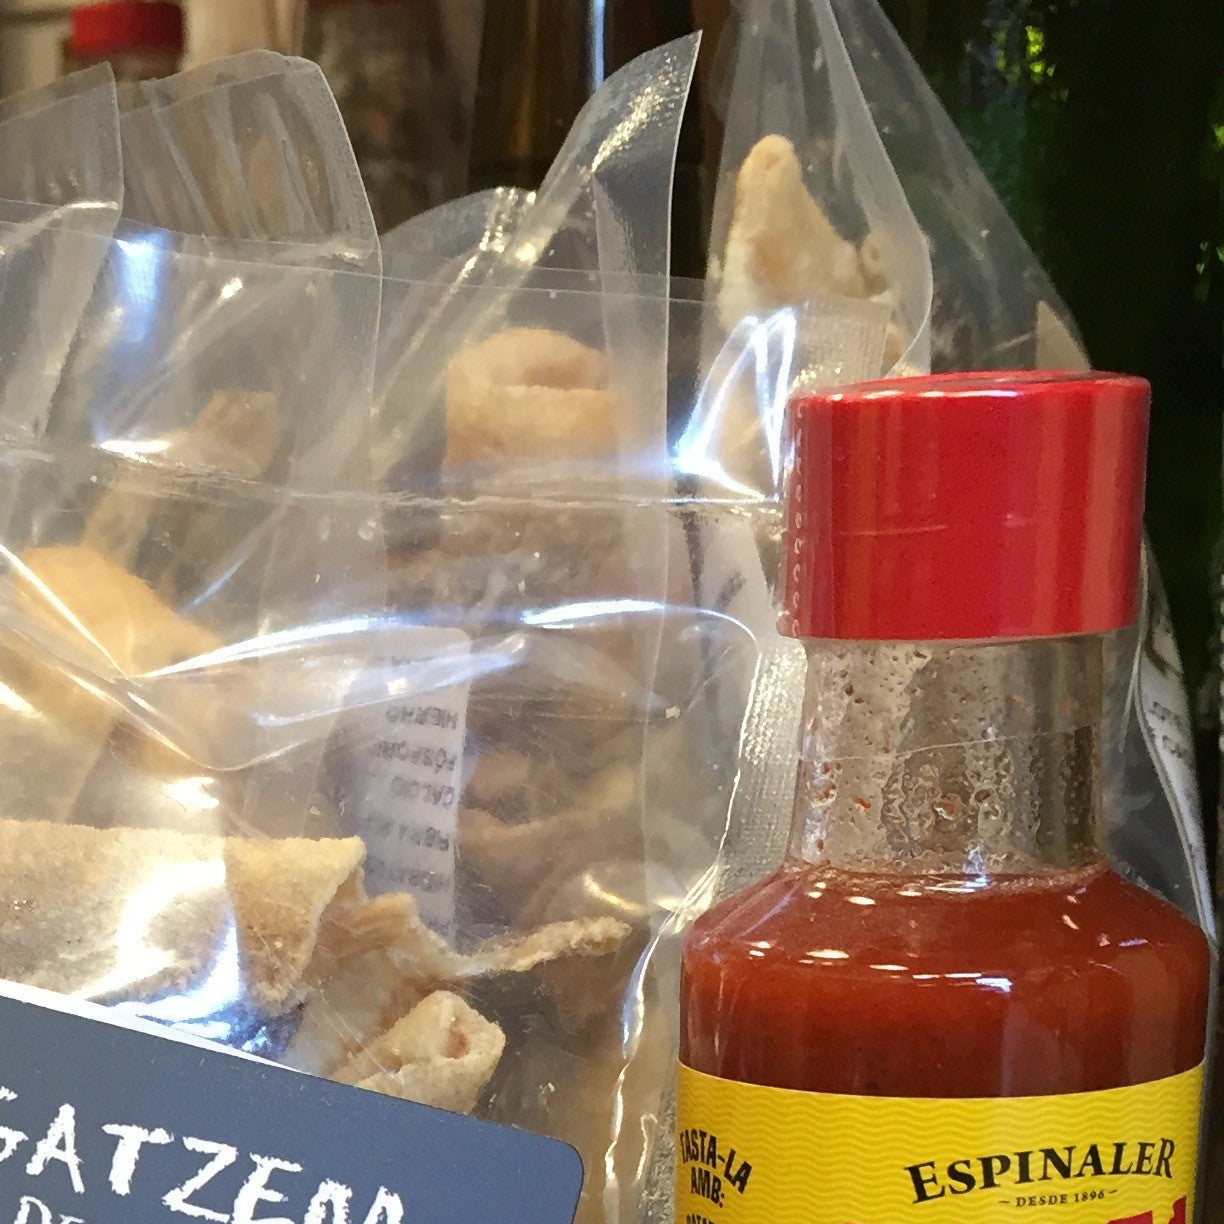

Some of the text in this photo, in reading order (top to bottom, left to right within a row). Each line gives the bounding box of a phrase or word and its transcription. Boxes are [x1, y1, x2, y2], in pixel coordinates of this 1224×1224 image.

[679, 1128, 753, 1195] TASTA-LA
[690, 1166, 725, 1209] AMB:
[904, 1137, 1176, 1205] ESPINALER
[1015, 1190, 1106, 1208] DESDE 1896
